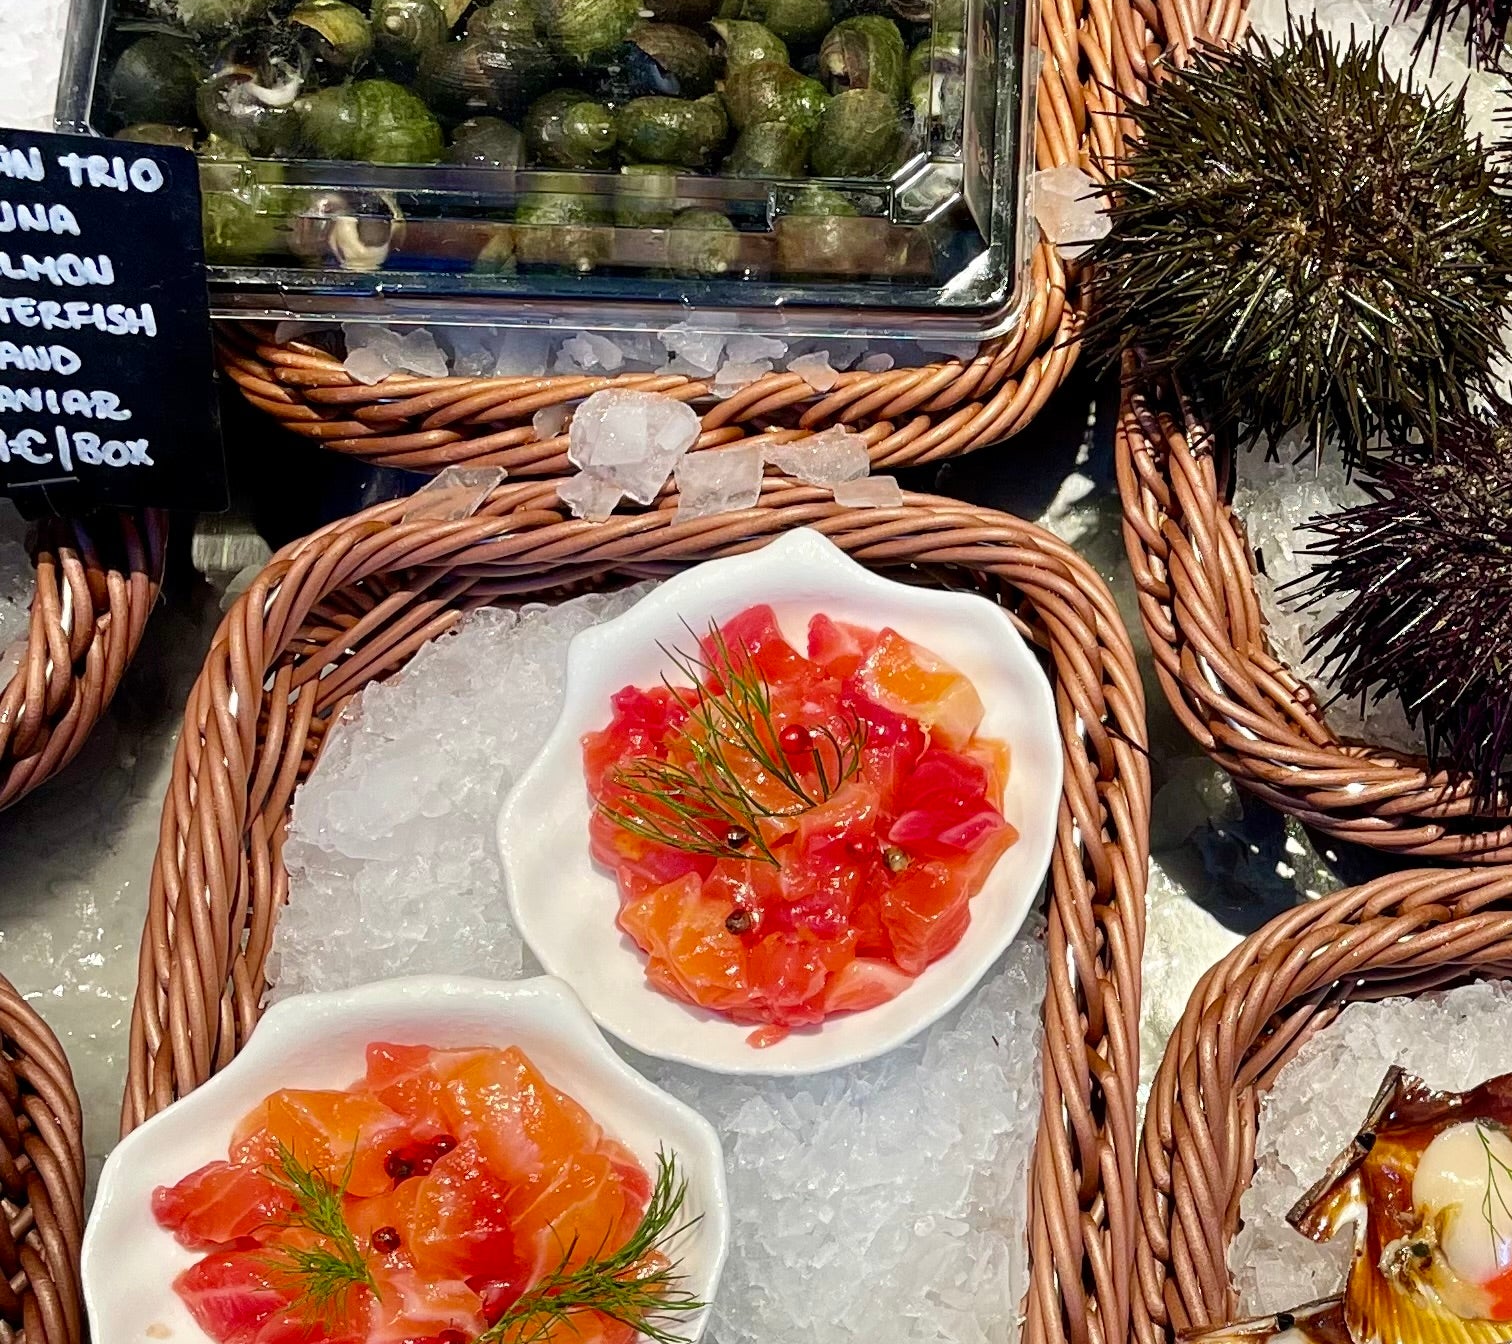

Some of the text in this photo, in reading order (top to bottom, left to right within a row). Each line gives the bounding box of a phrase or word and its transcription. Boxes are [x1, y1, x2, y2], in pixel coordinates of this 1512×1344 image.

[58, 153, 164, 192] TRIO
[0, 200, 81, 236] UNA
[0, 251, 115, 287] LMON
[0, 297, 157, 337] TERFISH
[0, 341, 82, 375] AND
[0, 385, 132, 421] AVIAR
